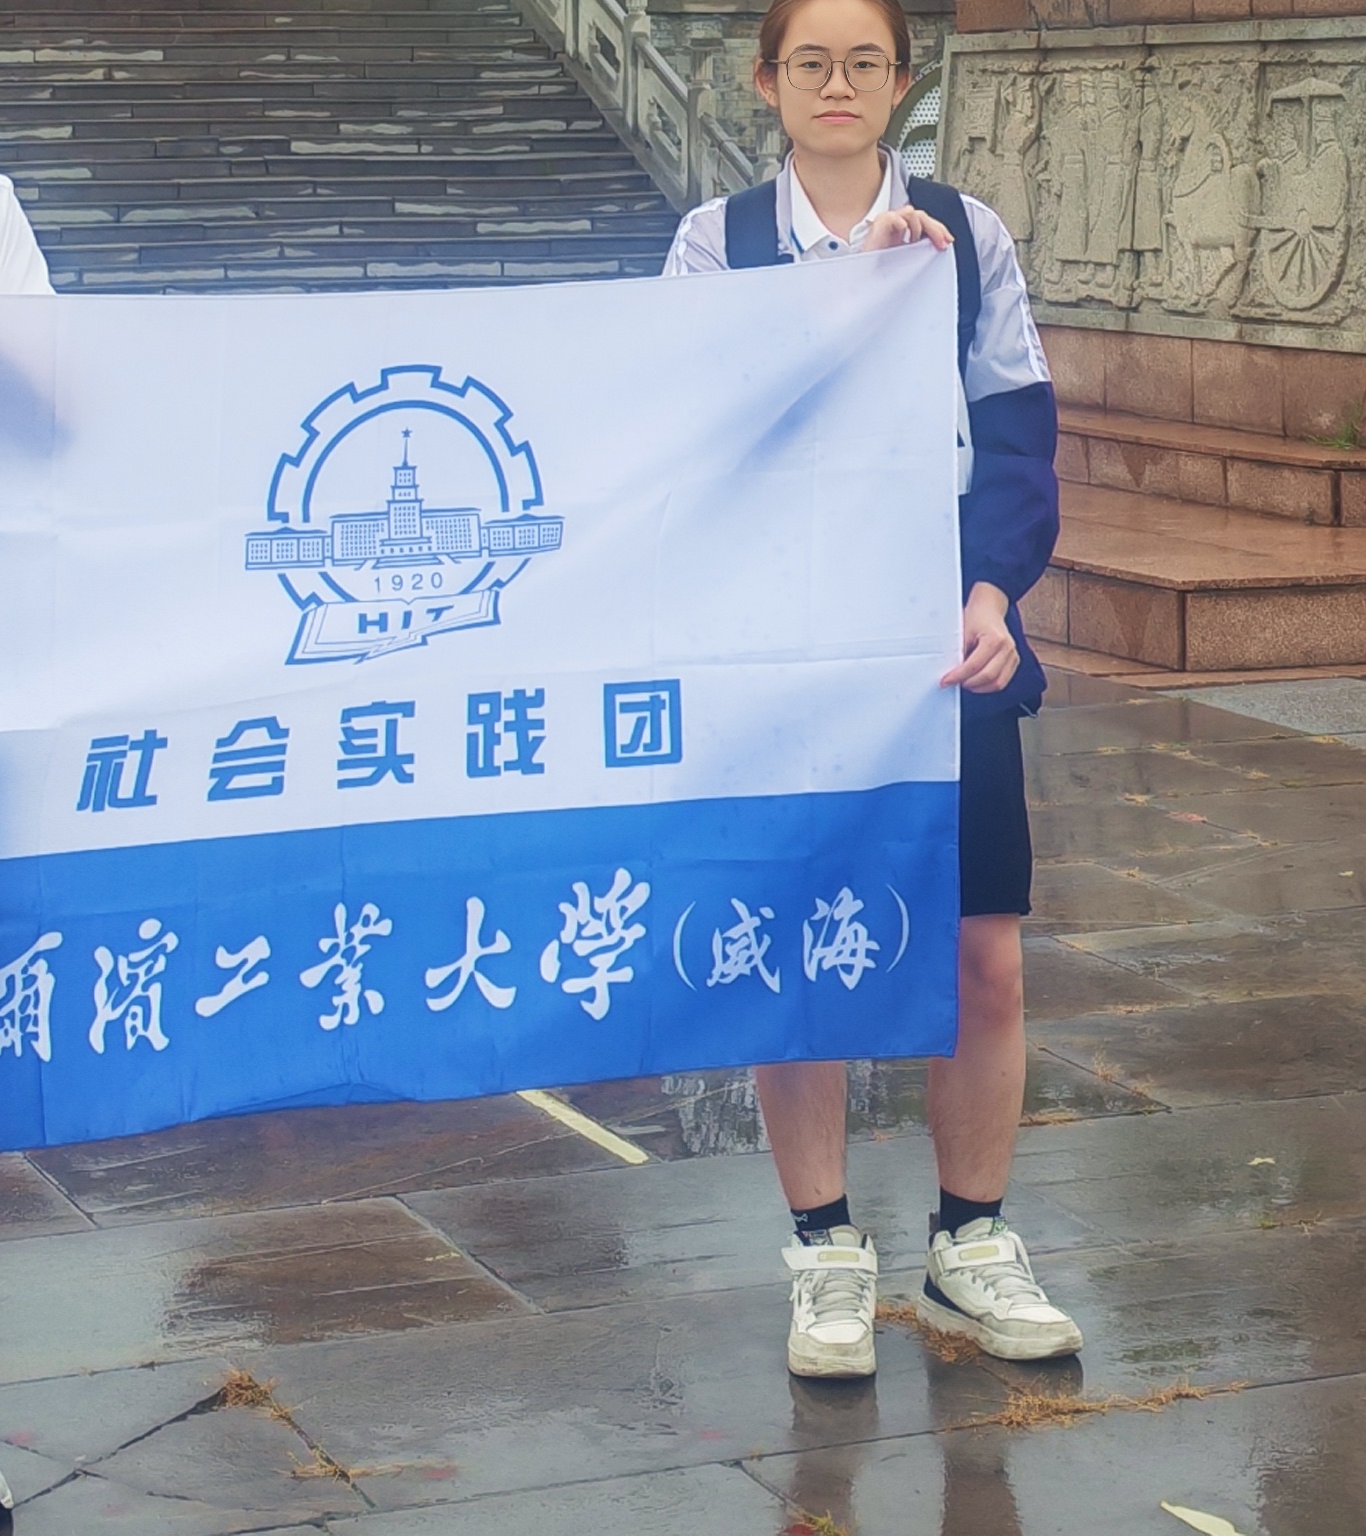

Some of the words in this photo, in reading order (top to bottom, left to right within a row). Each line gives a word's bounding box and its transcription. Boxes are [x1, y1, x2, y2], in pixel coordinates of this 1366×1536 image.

[373, 572, 443, 594] 1920
[357, 604, 444, 634] HIT
[76, 678, 683, 813] 社会实践团
